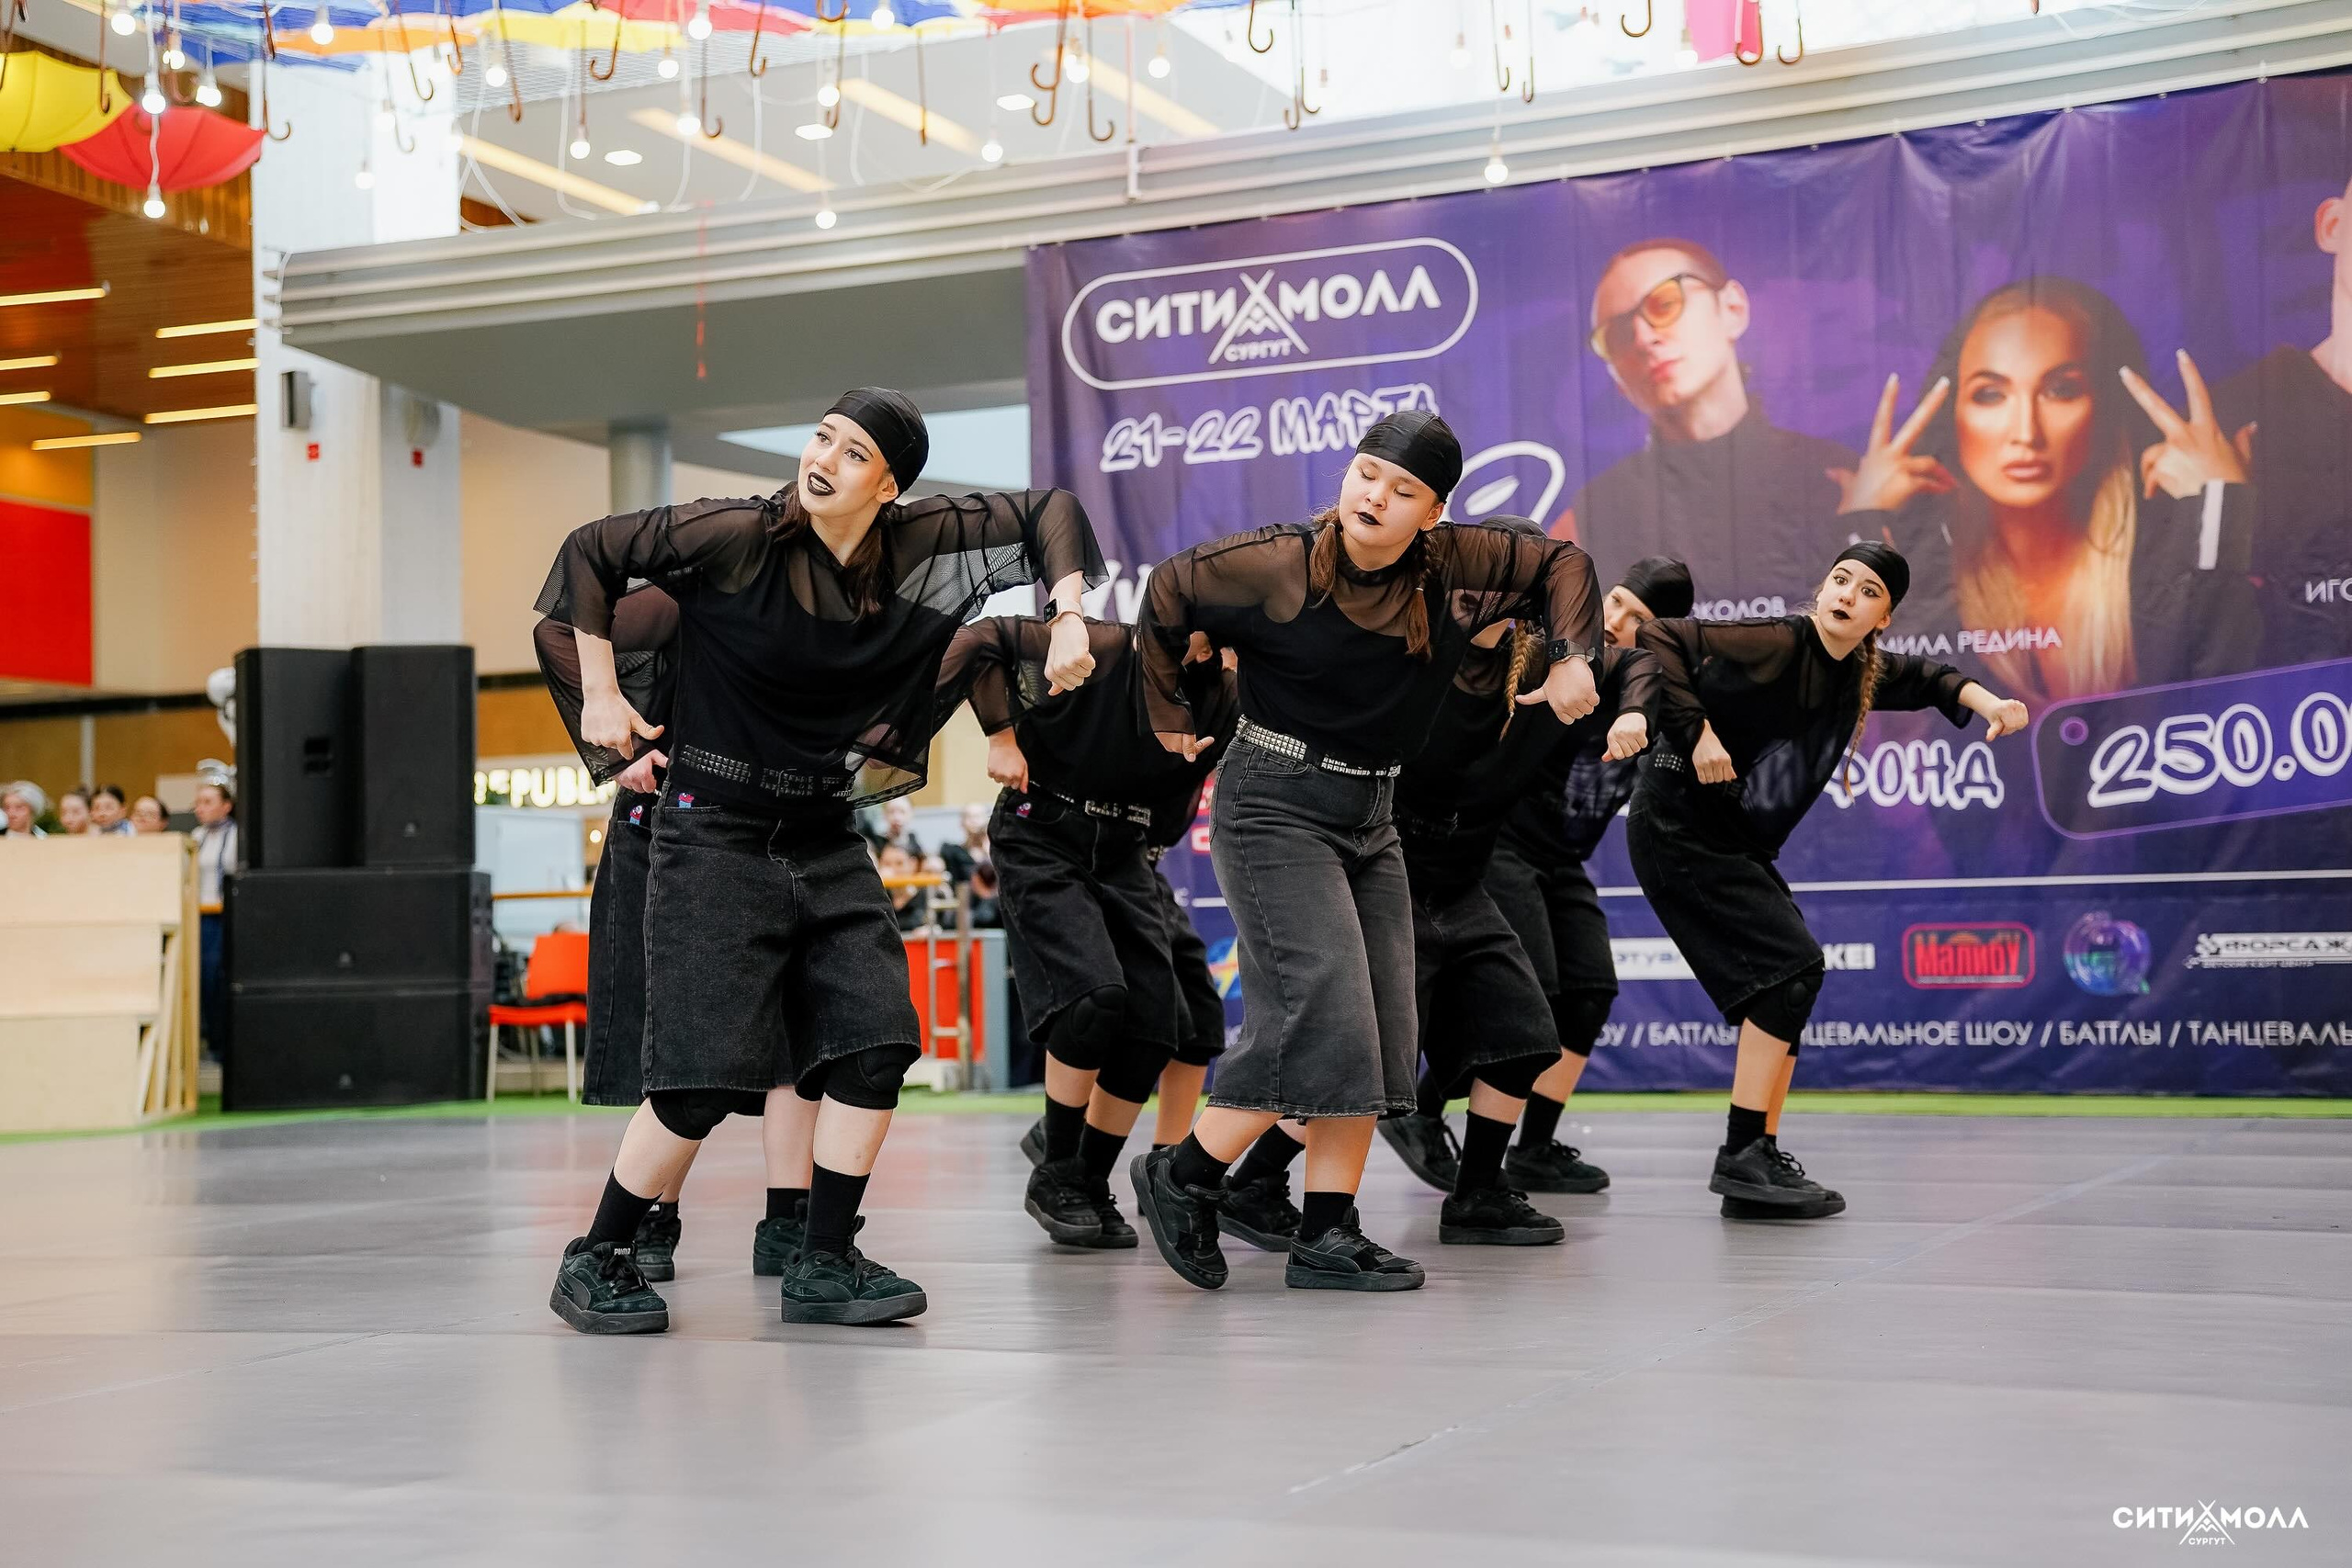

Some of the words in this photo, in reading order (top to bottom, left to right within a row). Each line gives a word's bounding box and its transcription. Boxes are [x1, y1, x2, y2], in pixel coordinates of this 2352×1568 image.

[1095, 287, 1238, 344] СИТИ
[1278, 265, 1442, 322] МОЛЛ
[1224, 337, 1294, 363] СУРГУТ
[1100, 405, 1264, 473] 21-22
[1957, 626, 2064, 655] РЕДИНА
[2086, 691, 2352, 808] 250.0
[1965, 1021, 2034, 1046] ШОУ
[2059, 1021, 2161, 1046] БАТТЛЫ
